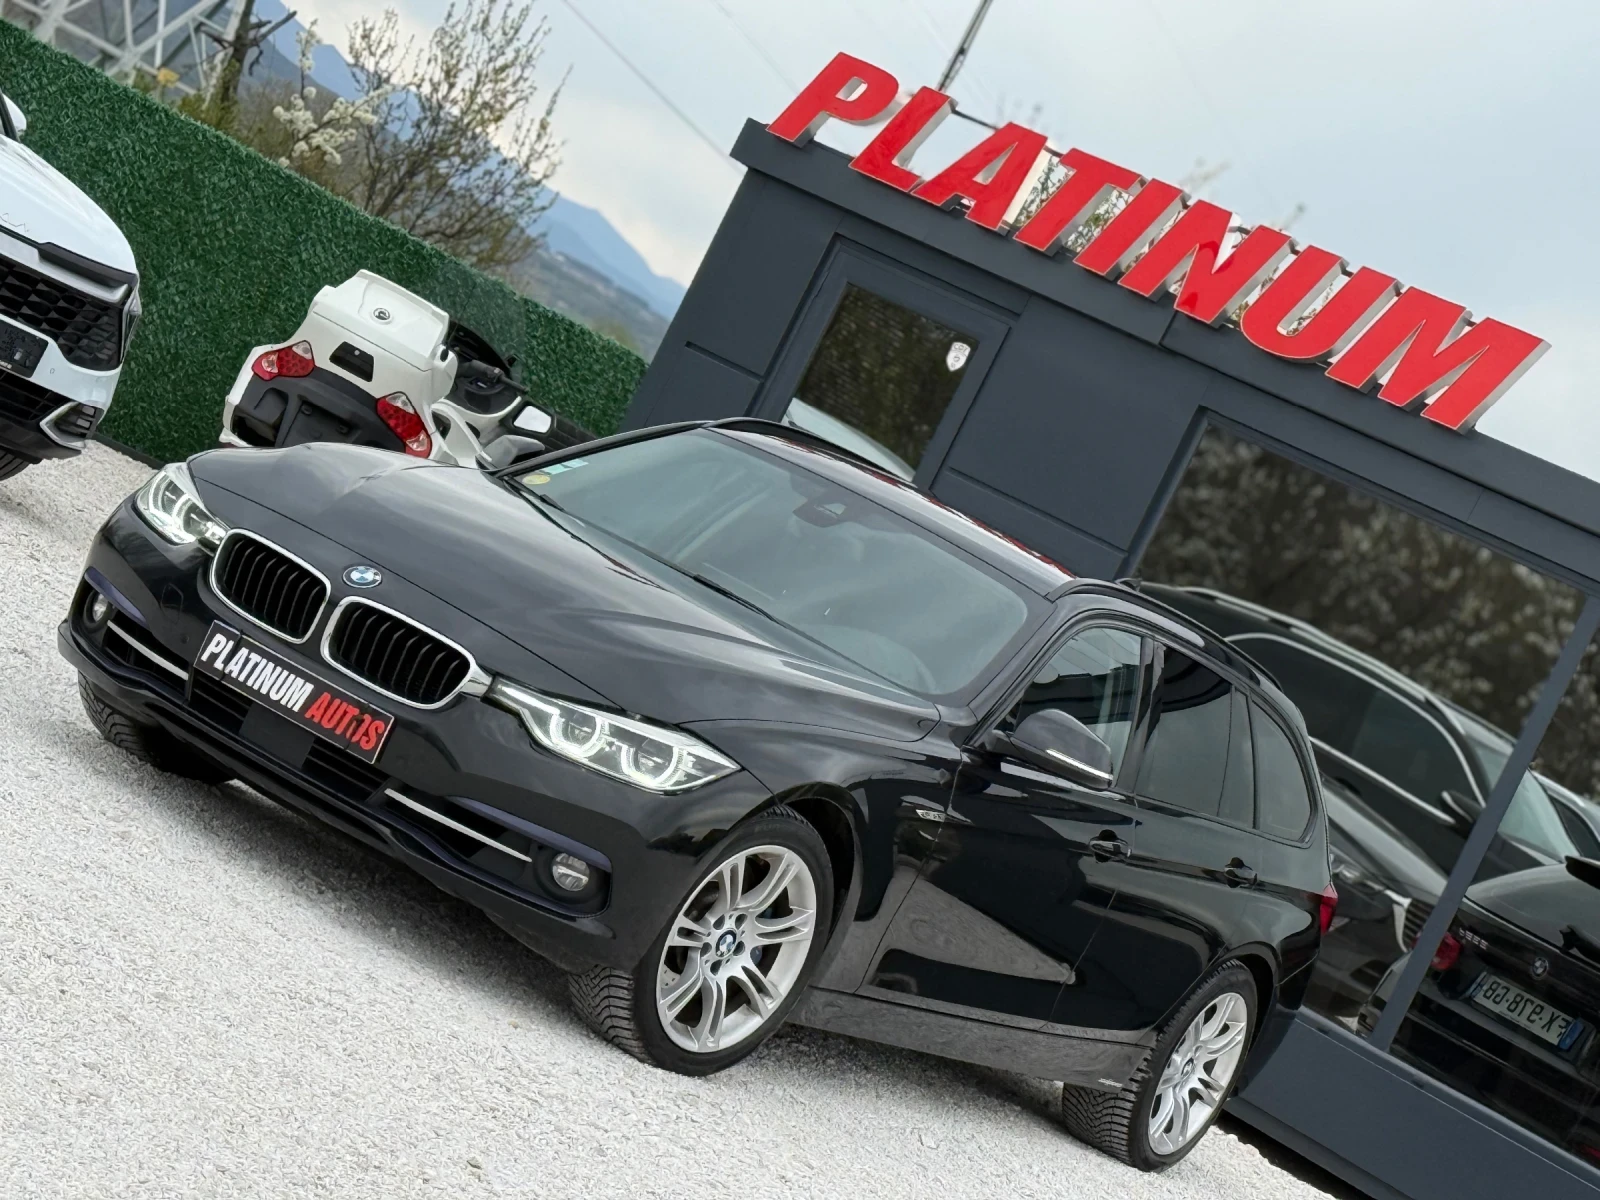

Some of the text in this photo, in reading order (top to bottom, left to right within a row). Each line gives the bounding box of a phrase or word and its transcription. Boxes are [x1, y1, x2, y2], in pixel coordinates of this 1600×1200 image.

[766, 51, 1547, 432] PLATINUM
[201, 633, 385, 750] PLATINUM AUTOS
